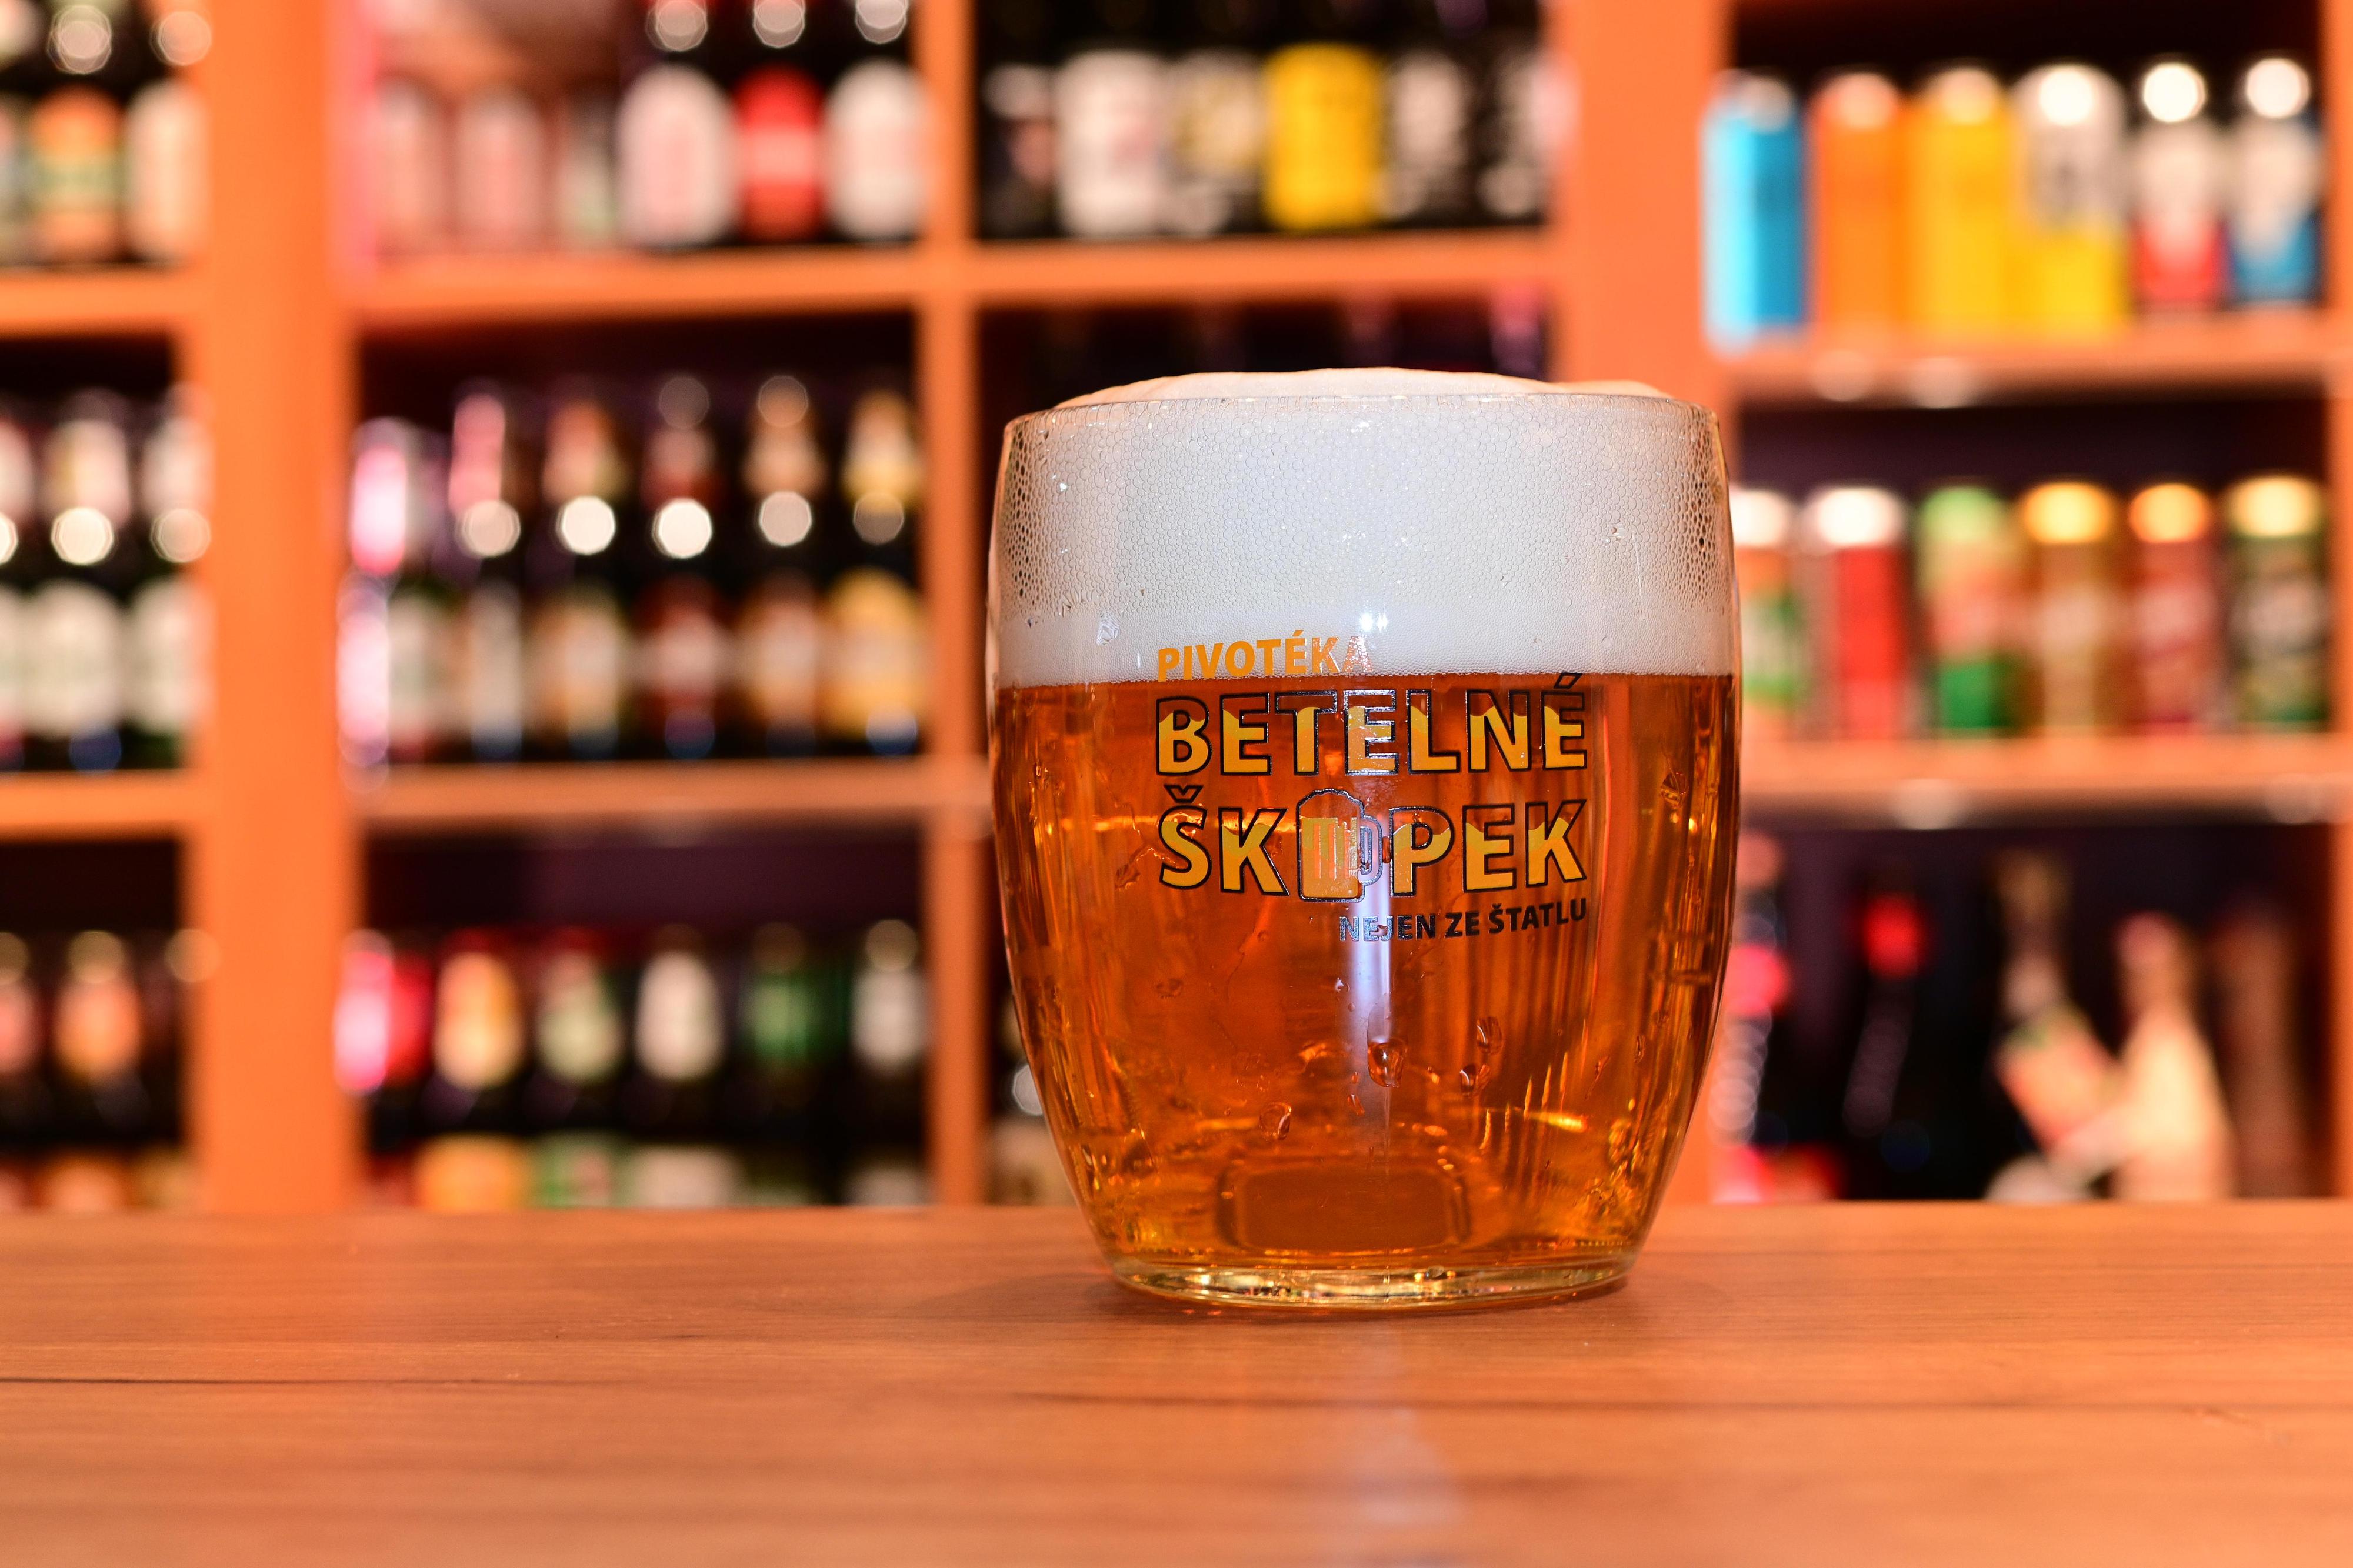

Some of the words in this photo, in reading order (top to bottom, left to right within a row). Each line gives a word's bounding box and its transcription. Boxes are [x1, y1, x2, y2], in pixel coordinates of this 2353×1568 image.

[1158, 629, 1373, 682] PIVOTÉKA
[1155, 672, 1588, 776] BETELNÉ
[1158, 783, 1588, 905] ŠKPEK
[1338, 913, 1437, 942] NEJEN
[1445, 909, 1480, 939] ZE
[1488, 898, 1587, 935] ŠTATLU
